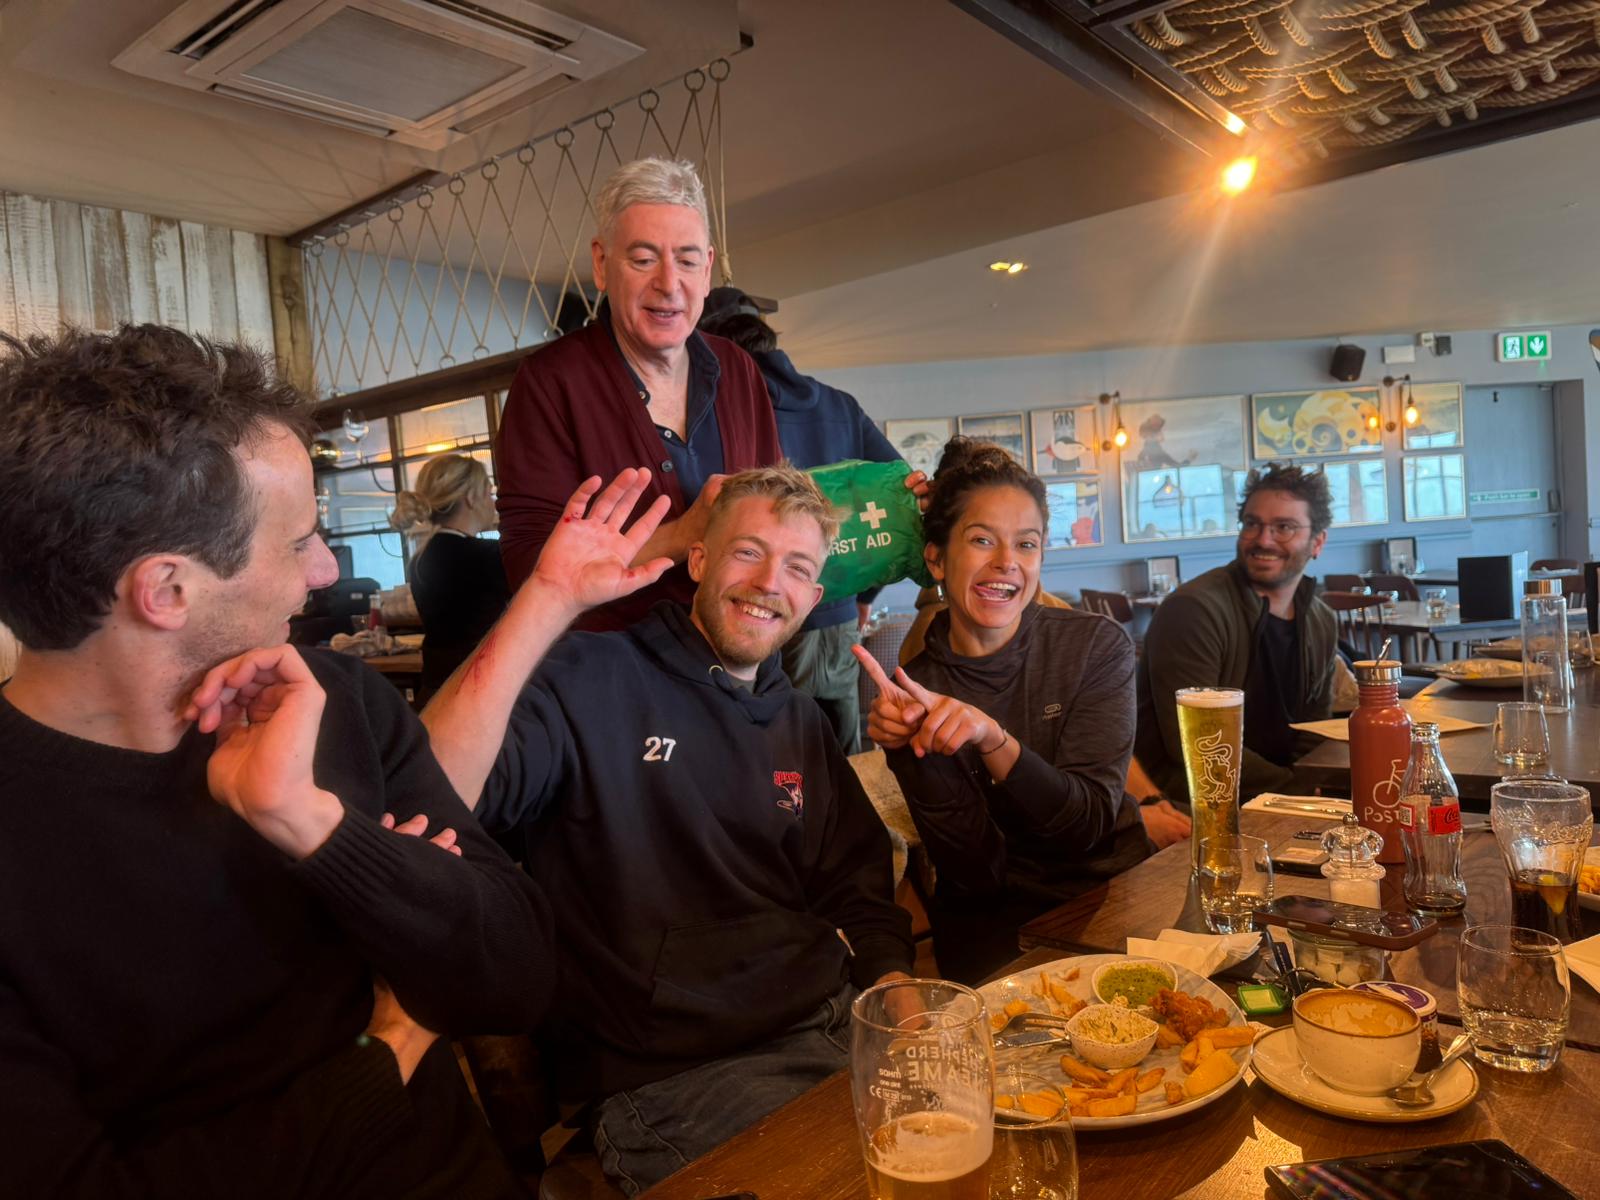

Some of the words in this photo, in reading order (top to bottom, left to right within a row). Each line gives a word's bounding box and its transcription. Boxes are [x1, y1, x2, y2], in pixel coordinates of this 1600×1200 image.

[828, 538, 857, 556] RST
[866, 531, 891, 549] AID
[643, 736, 676, 761] 27
